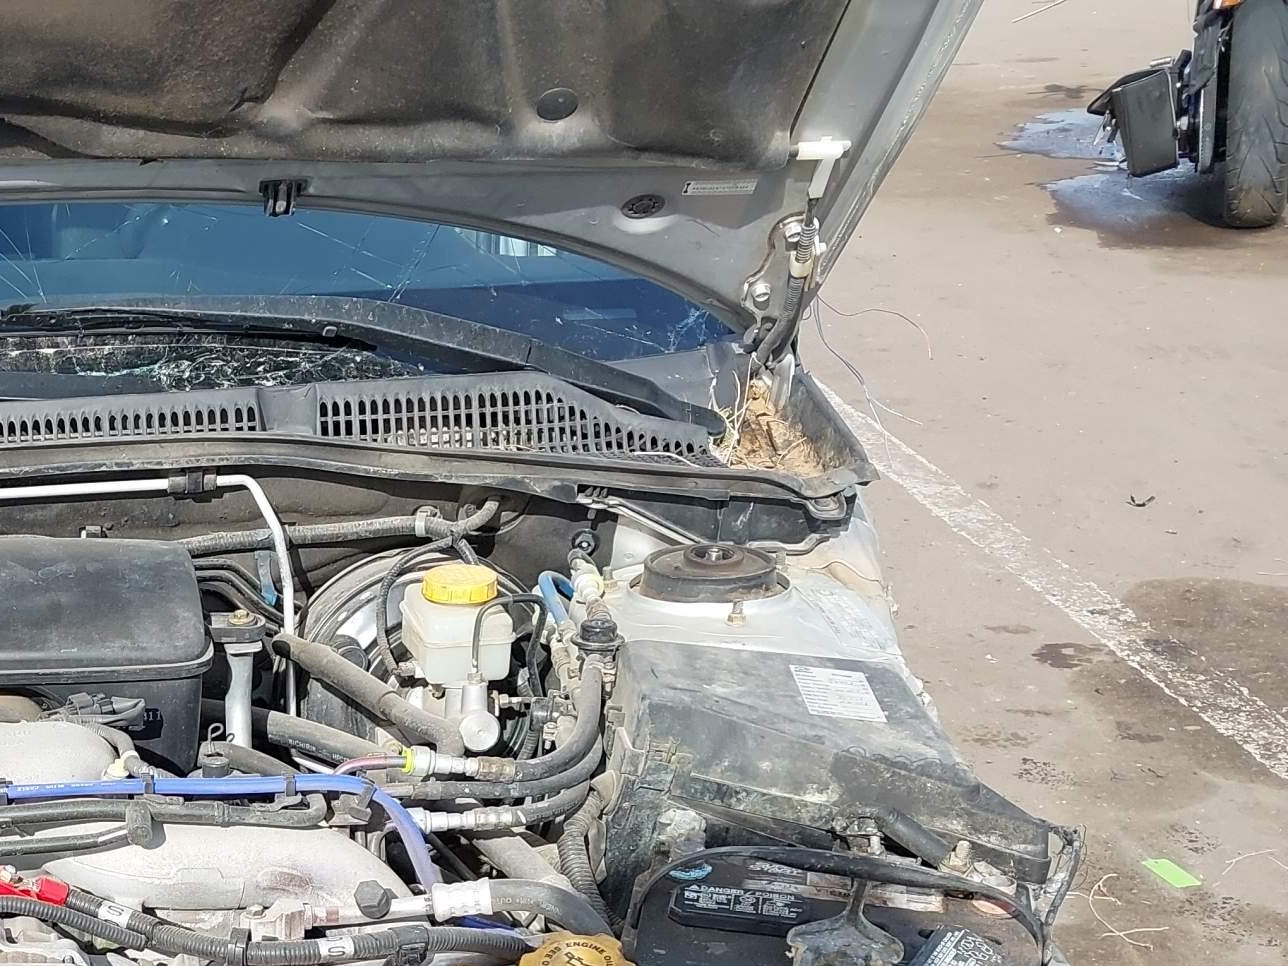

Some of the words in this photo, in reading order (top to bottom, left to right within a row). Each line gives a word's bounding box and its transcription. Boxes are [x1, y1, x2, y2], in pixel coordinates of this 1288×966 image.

[327, 945, 346, 957] S
[543, 945, 562, 961] SEE
[565, 941, 607, 955] ENGINE
